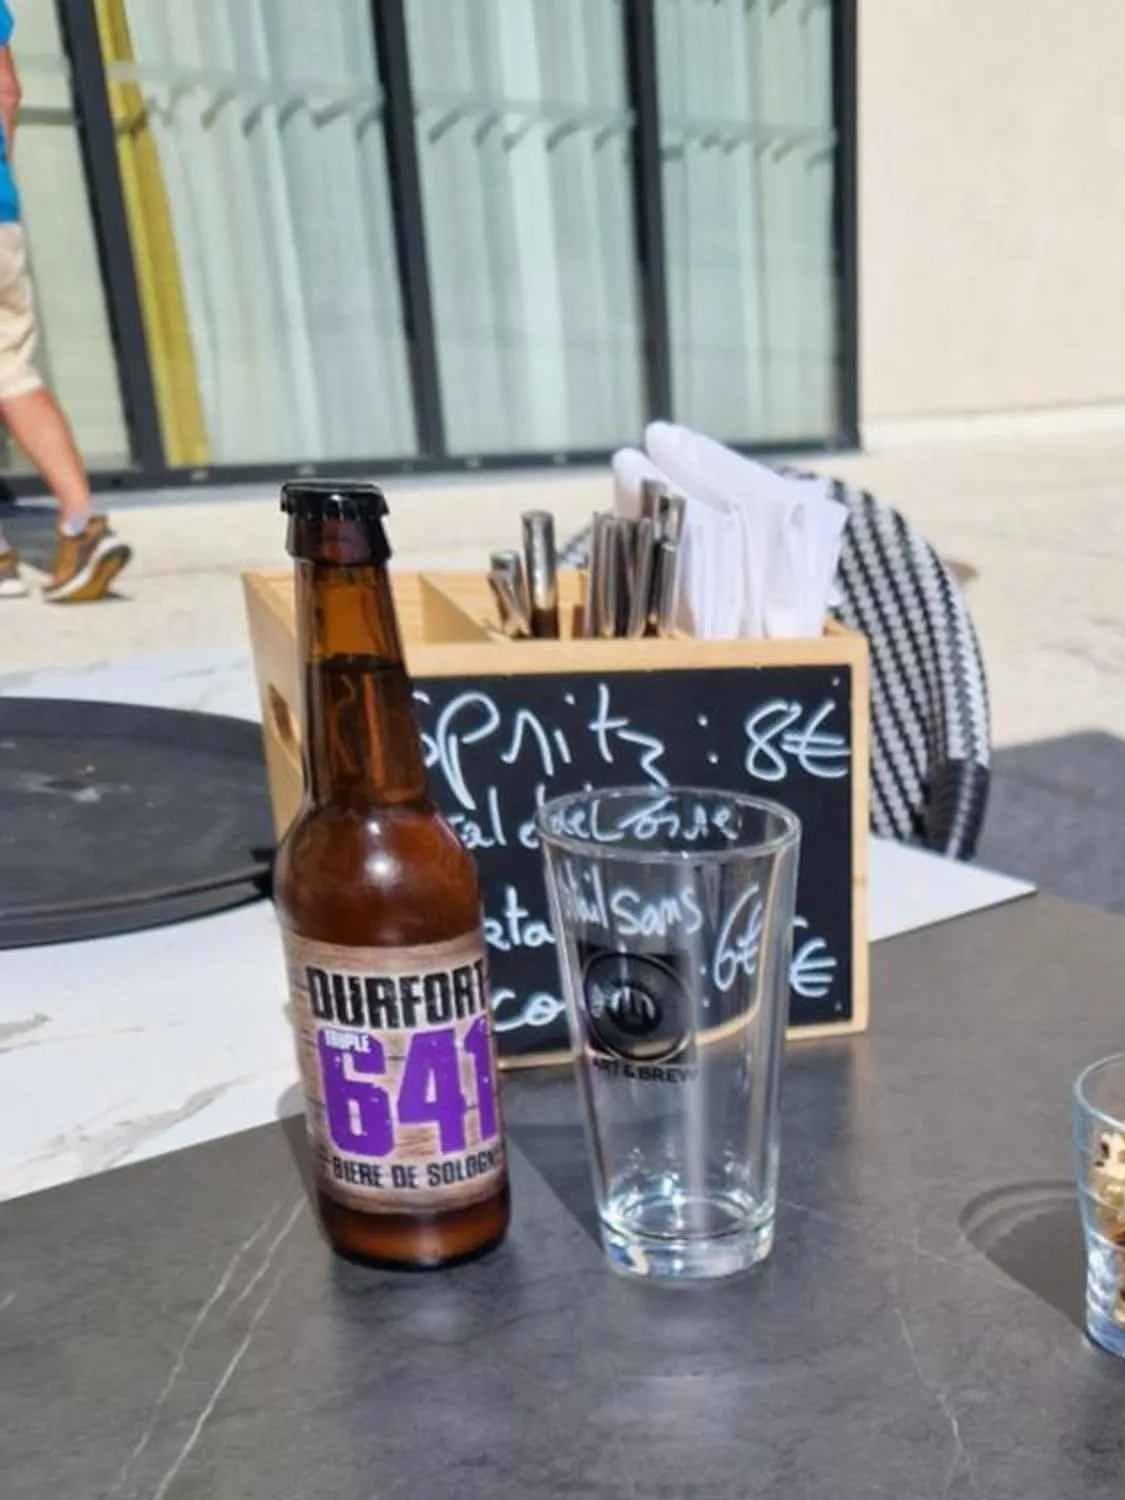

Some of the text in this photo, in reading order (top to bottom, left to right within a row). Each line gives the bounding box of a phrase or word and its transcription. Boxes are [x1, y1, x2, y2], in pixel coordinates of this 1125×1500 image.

[305, 958, 487, 1029] DURFORT
[317, 1015, 497, 1158] 641
[392, 1164, 419, 1189] DE
